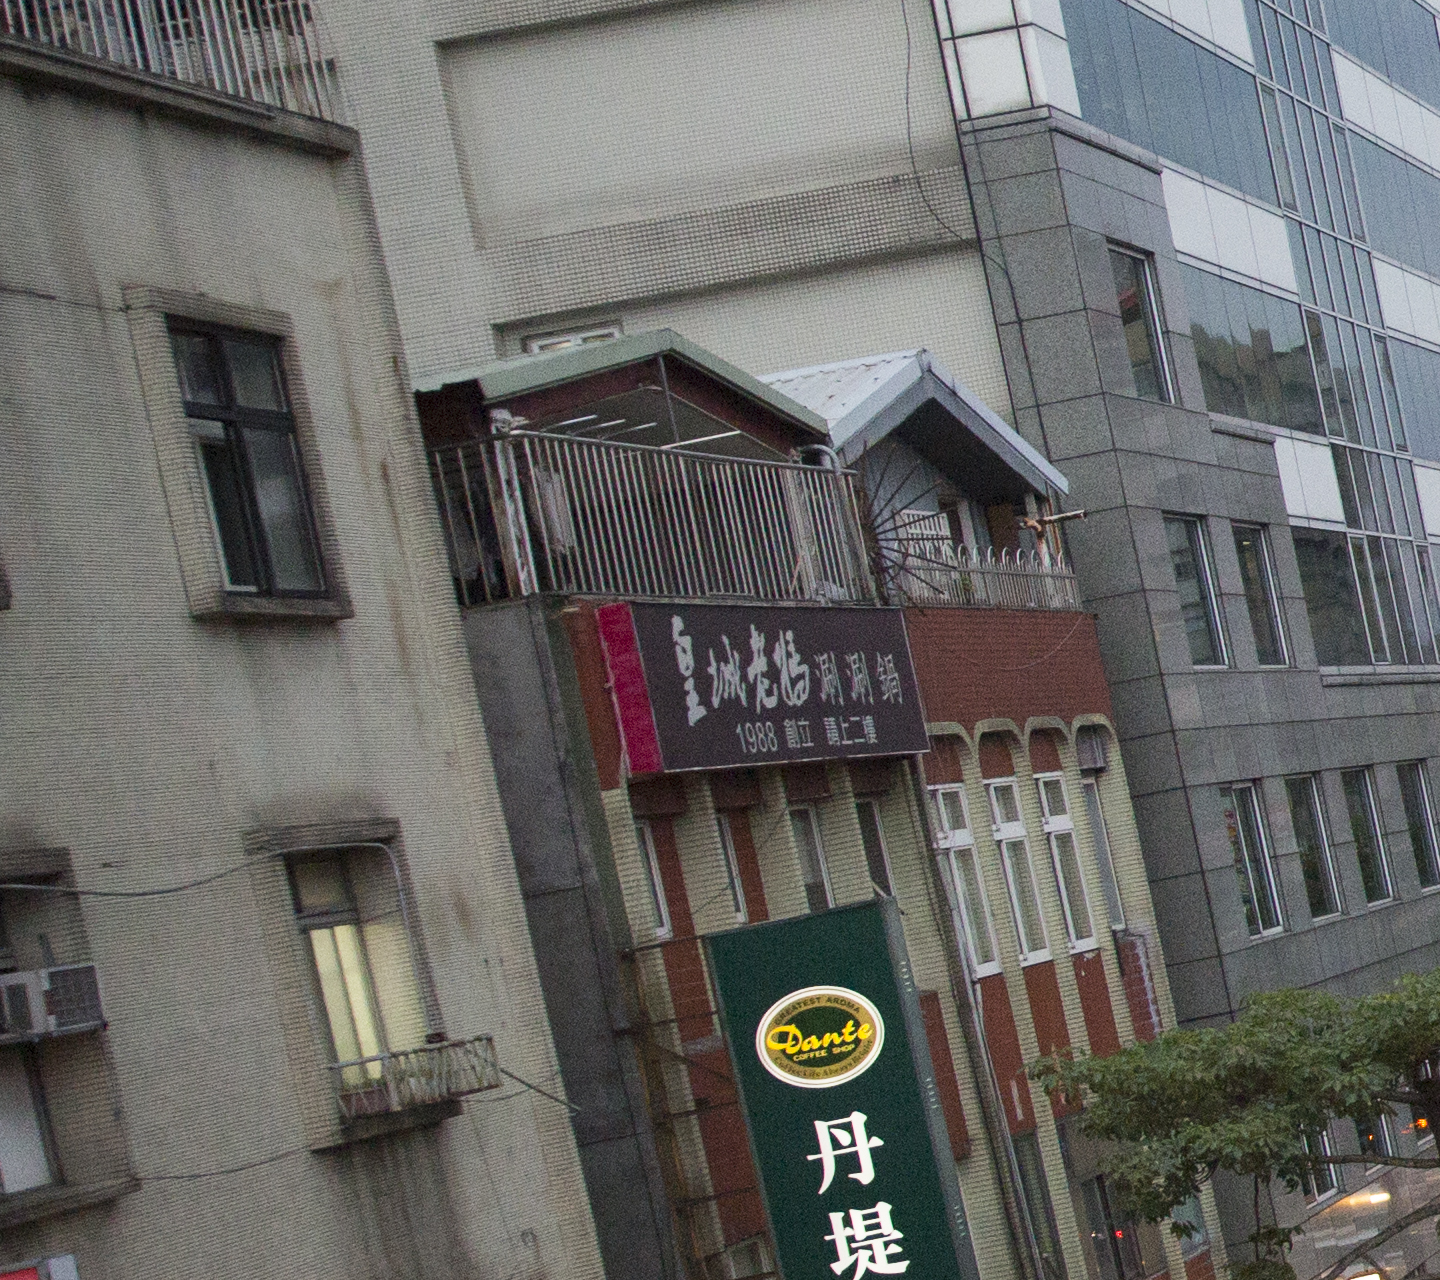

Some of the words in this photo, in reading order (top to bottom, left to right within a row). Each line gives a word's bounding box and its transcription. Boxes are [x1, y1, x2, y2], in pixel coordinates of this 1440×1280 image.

[735, 722, 779, 754] 1988
[766, 1019, 873, 1055] Dante
[793, 1048, 828, 1062] COFFEE
[831, 1043, 856, 1054] SHOP
